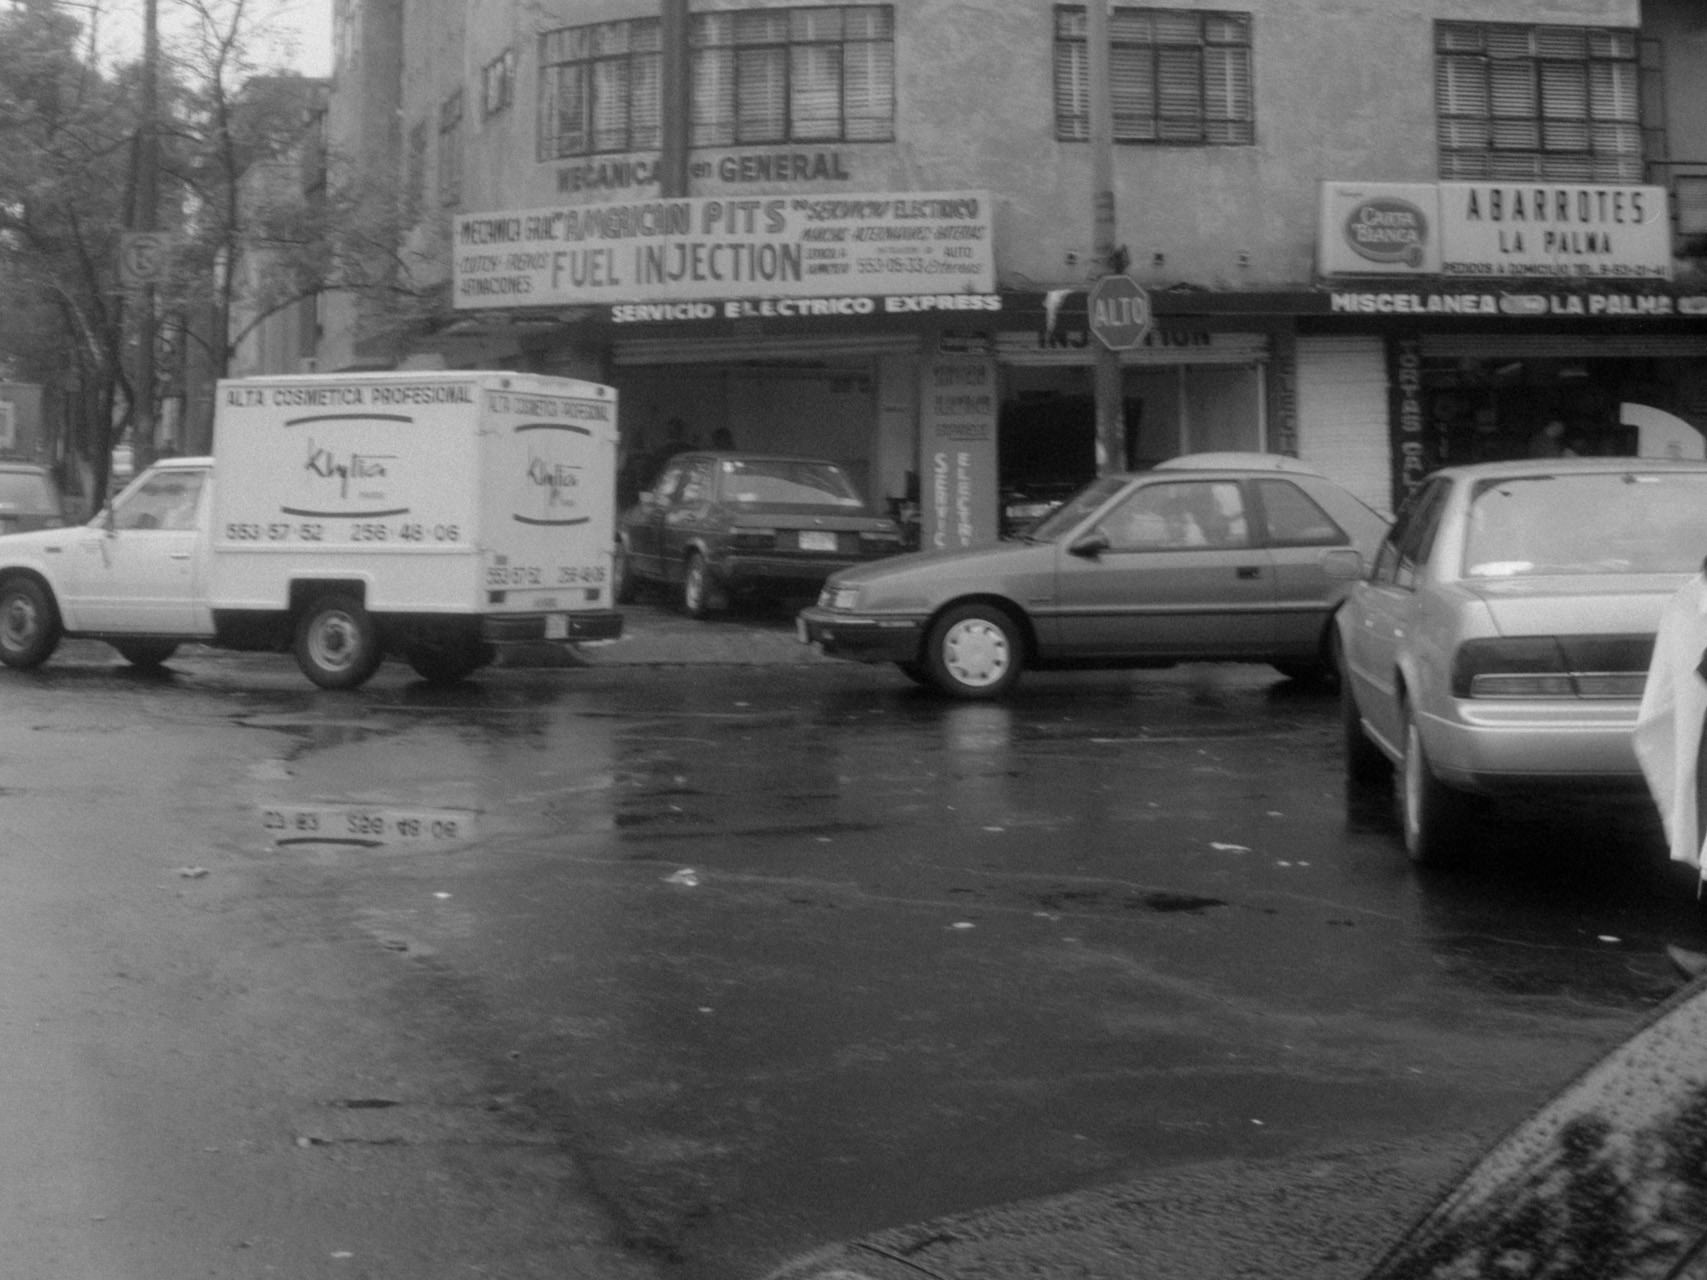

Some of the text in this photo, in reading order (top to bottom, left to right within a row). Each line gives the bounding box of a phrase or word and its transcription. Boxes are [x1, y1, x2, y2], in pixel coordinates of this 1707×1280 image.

[717, 153, 849, 182] GENERAL
[1466, 188, 1644, 224] ABARROTES
[1498, 231, 1613, 254] LA PALMA
[551, 243, 802, 290] FUEL INJECTION
[611, 292, 1003, 322] SERVICIO ELECTRICO EXPRESS
[1095, 297, 1145, 327] ALTO
[1330, 293, 1673, 314] MISCELANEA LA PALMA
[226, 385, 475, 408] ALTA COSMETICA PROFESIONAL
[1399, 339, 1423, 432] TORTAS
